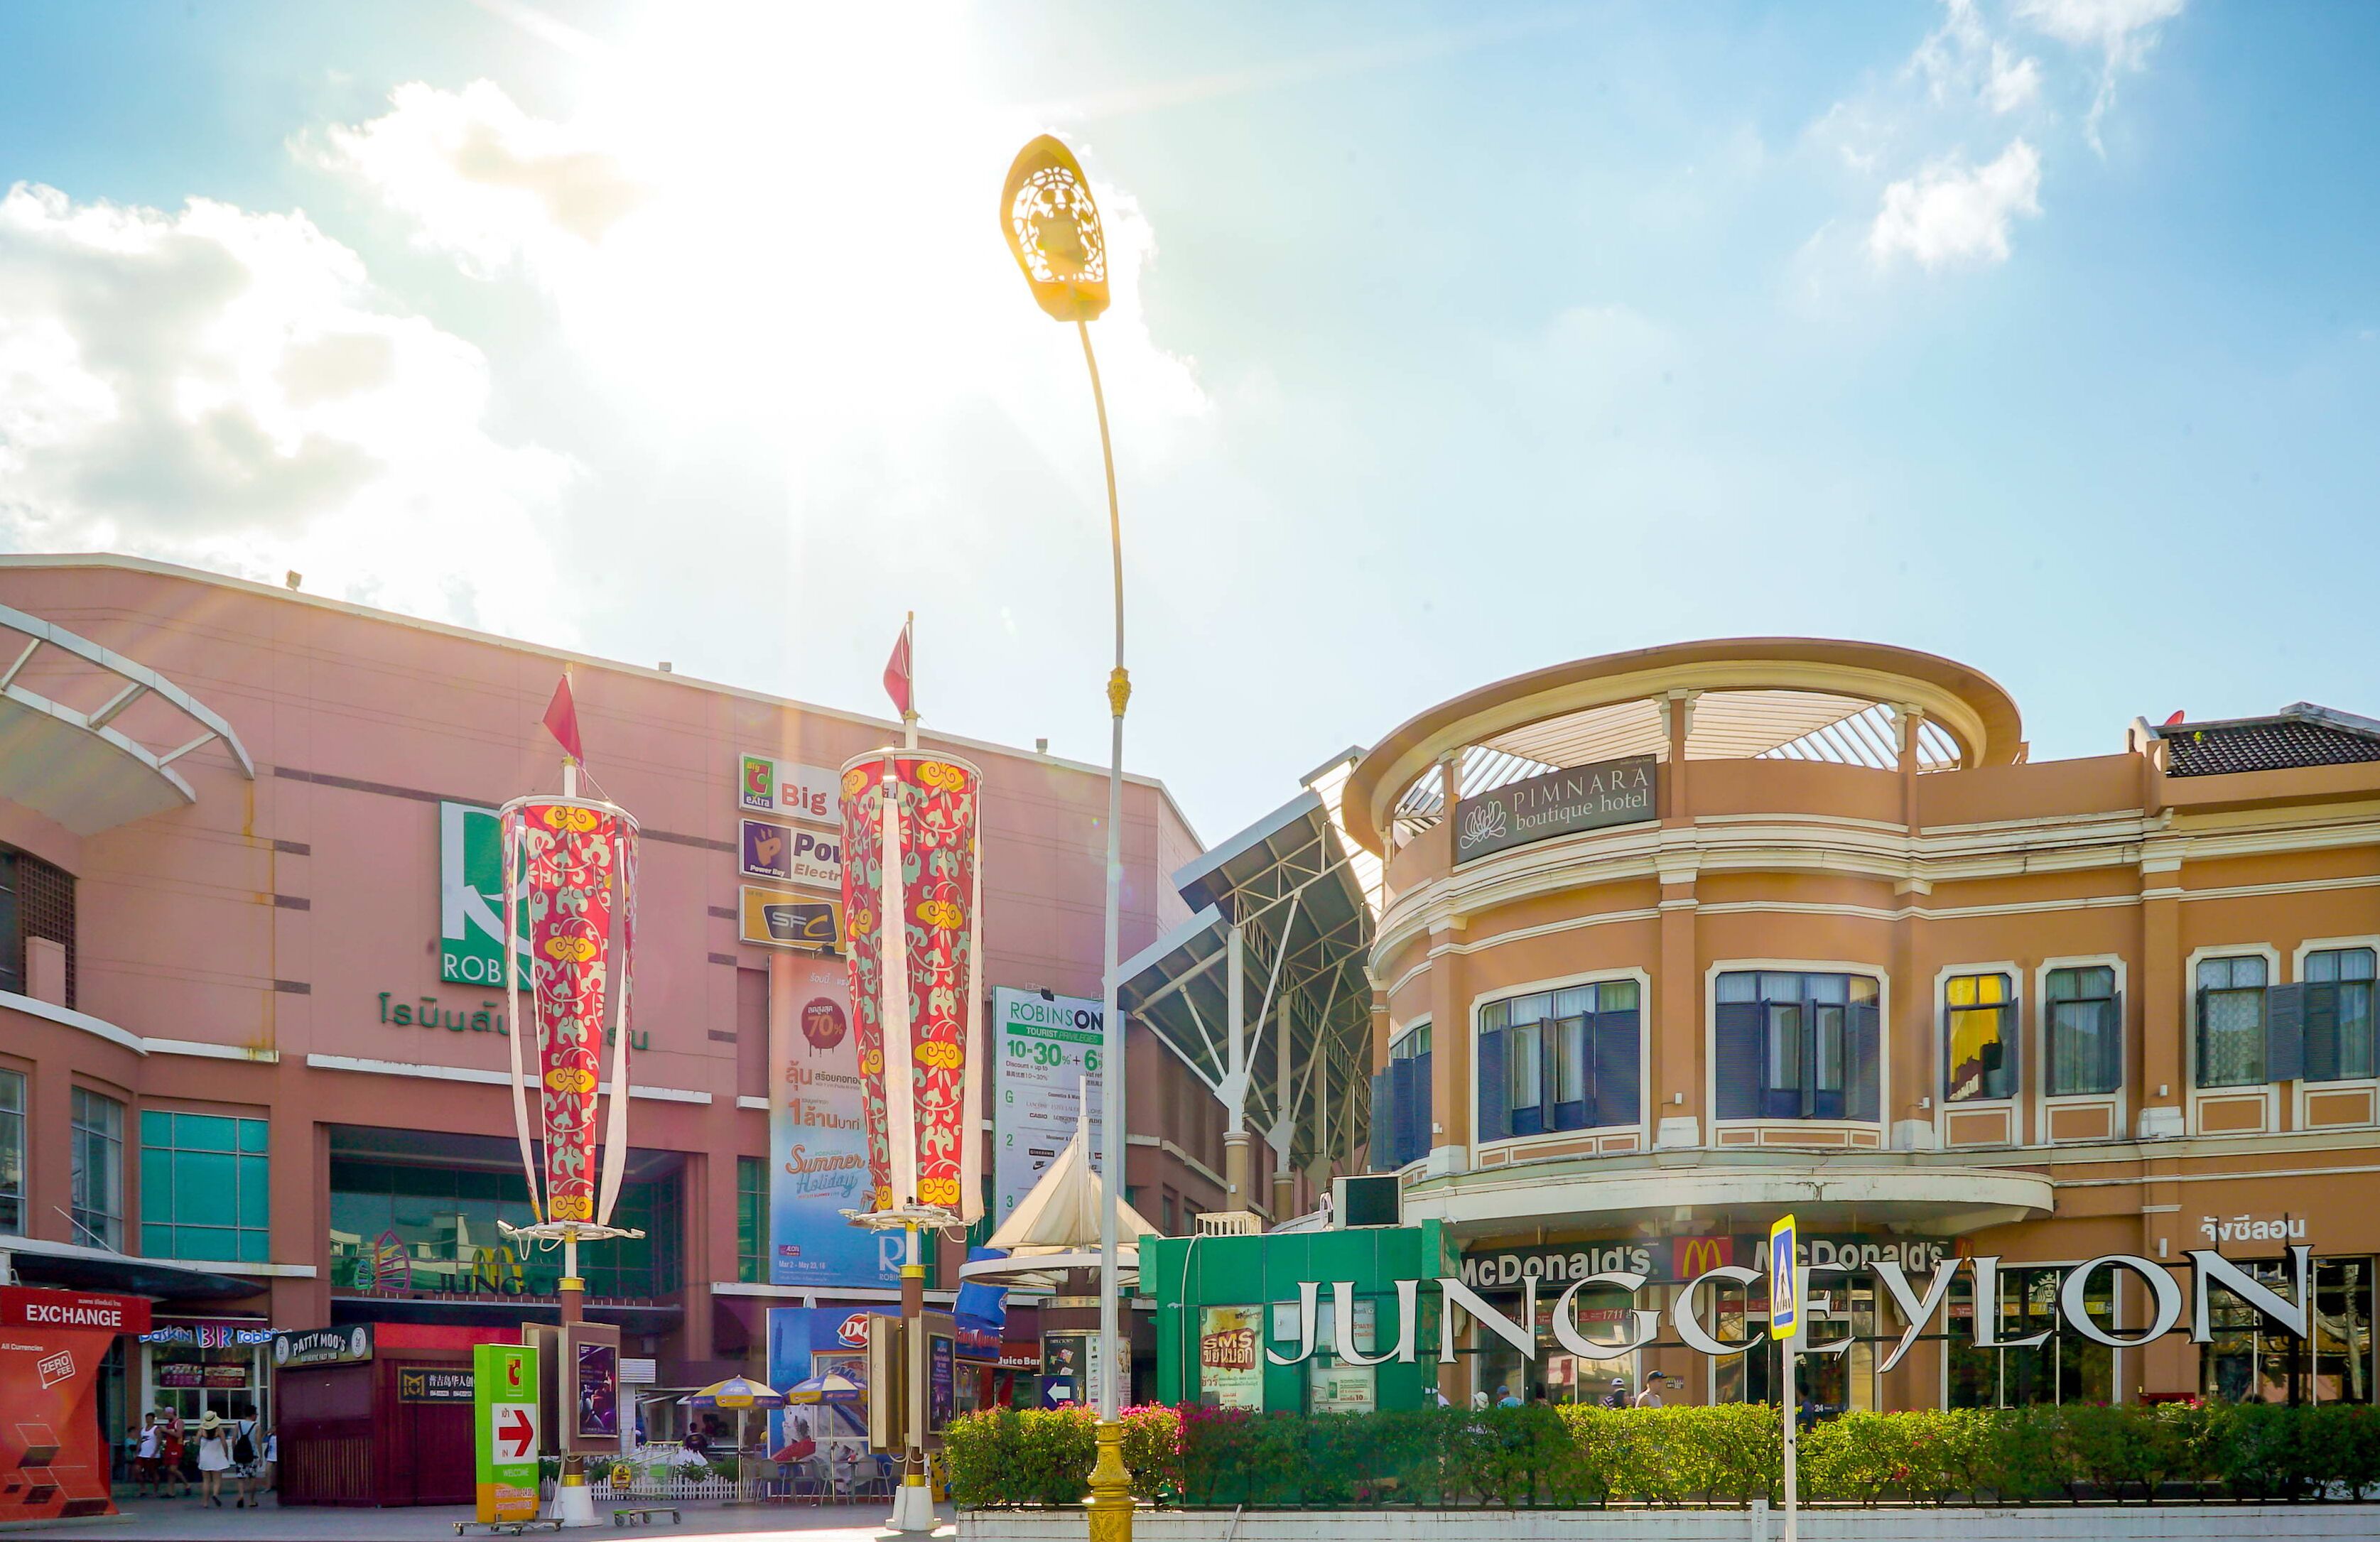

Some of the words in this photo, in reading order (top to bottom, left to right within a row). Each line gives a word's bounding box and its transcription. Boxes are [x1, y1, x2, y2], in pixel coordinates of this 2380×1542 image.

[1513, 767, 1649, 811] PIMNARA
[746, 795, 770, 808] extra
[781, 783, 827, 816] Big
[1516, 801, 1593, 831] boutique
[1600, 789, 1648, 813] hotel
[750, 864, 772, 874] Power
[772, 867, 786, 878] Buy
[772, 911, 835, 938] SFC
[444, 953, 502, 983] ROB
[807, 1014, 843, 1037] 70%
[1010, 1001, 1103, 1032] ROBINSON
[1027, 1026, 1058, 1038] TOURIST
[1006, 1060, 1029, 1069] Discount
[1005, 1089, 1014, 1103] G
[1006, 1134, 1013, 1146] 2
[785, 1144, 865, 1175] Summer
[796, 1171, 859, 1198] Holiday
[1006, 1194, 1014, 1208] 3
[2200, 1214, 2305, 1243] จังซีลอน
[799, 1261, 810, 1270] May
[1459, 1246, 1651, 1287] McDonald's
[26, 1304, 121, 1327] EXCHANGE
[1266, 1244, 2316, 1377] JUNGCEYLON
[11, 1342, 44, 1352] Currencies
[293, 1333, 319, 1357] PATTY
[320, 1332, 347, 1353] MOO'S
[1203, 1330, 1253, 1350] SMS
[41, 1355, 70, 1374] ZERO
[57, 1364, 72, 1376] FEE
[998, 1356, 1023, 1365] Juice
[1023, 1357, 1041, 1365] Bar
[429, 1374, 475, 1387] 普吉岛华人创
[1814, 1404, 1824, 1413] 24
